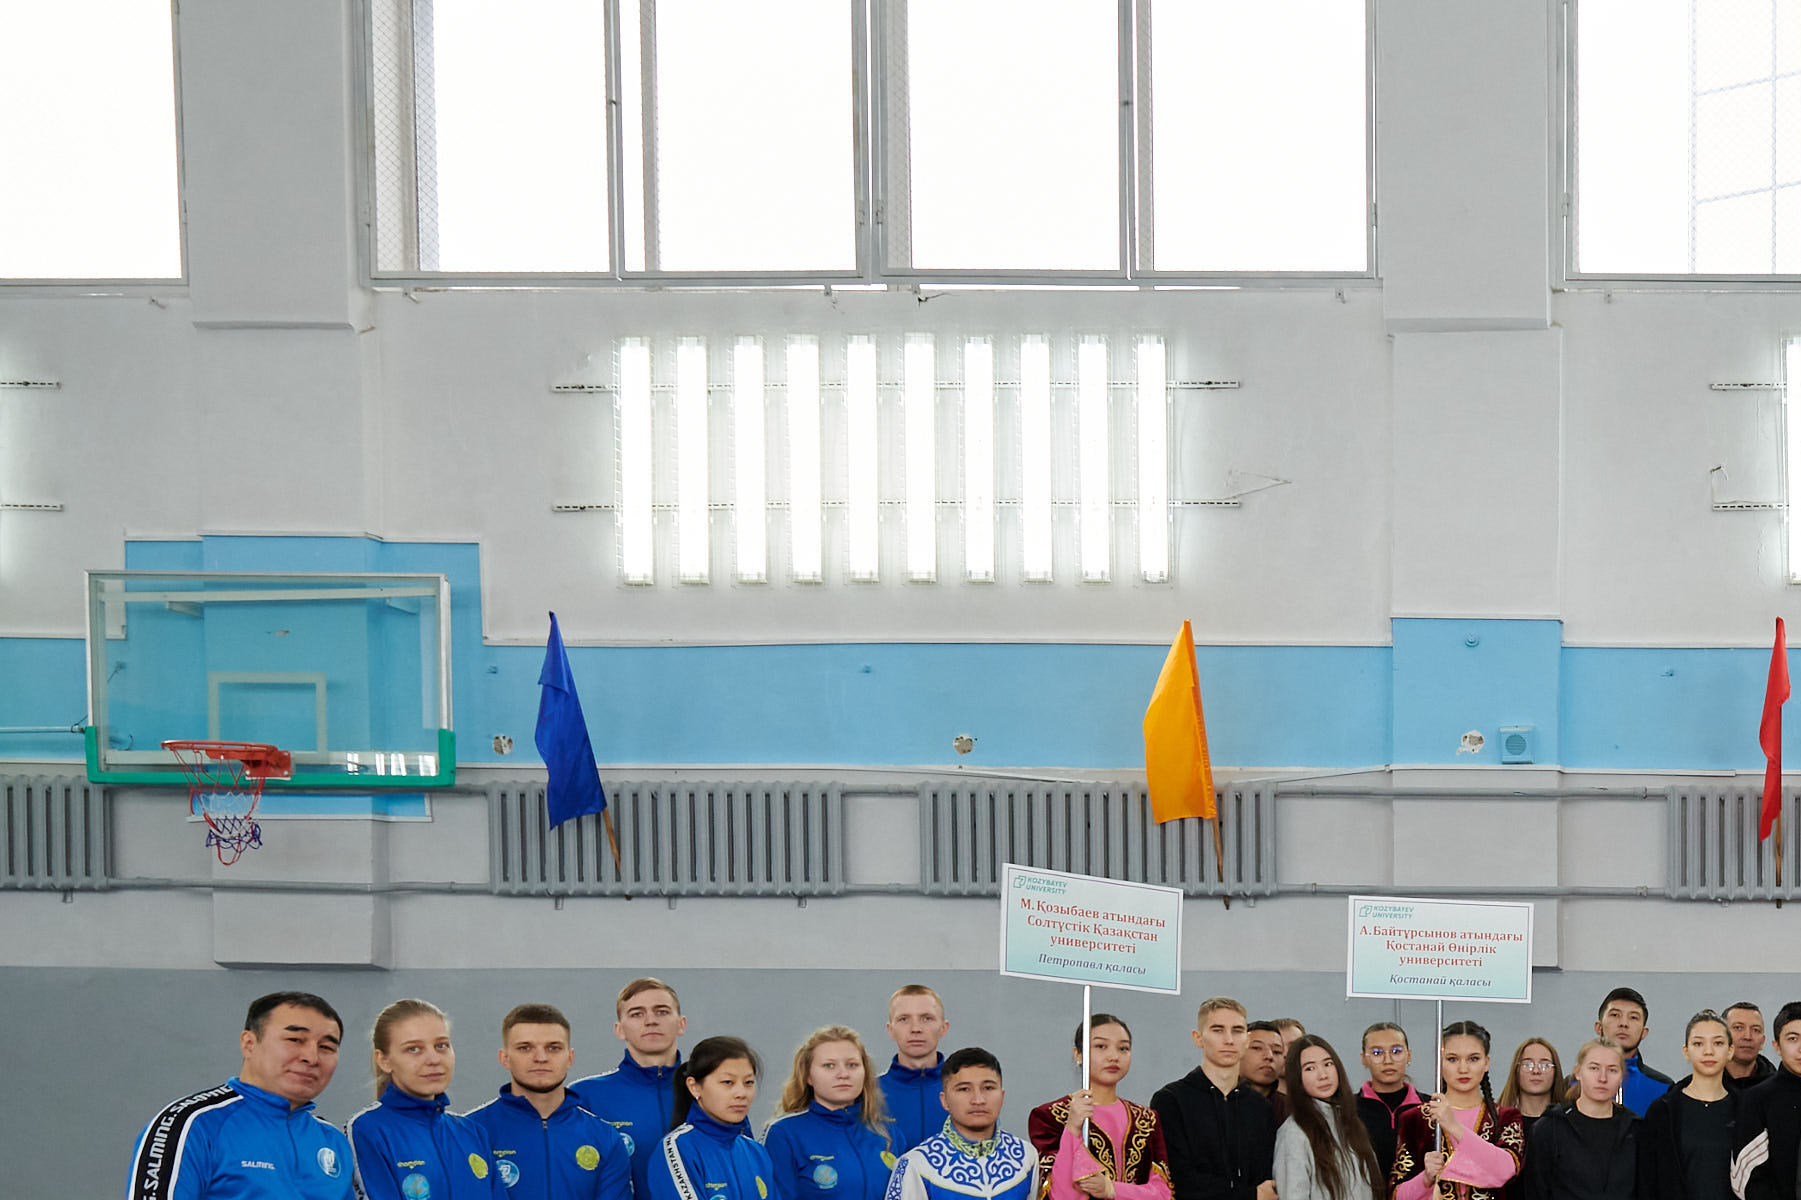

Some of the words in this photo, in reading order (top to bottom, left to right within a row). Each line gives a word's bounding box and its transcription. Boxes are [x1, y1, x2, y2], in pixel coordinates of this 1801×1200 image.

[1027, 877, 1068, 888] KOZYBAYEV
[1026, 884, 1066, 895] UNIVERSITY
[1372, 905, 1415, 913] KOZYBAYEV
[1103, 911, 1166, 928] атындағы
[1027, 915, 1090, 933] Солтүстік
[1093, 924, 1158, 942] Қазақстан
[1460, 931, 1523, 942] атындағы
[1050, 935, 1137, 954] университеті
[1386, 940, 1445, 952] Қостанай
[1038, 953, 1103, 971] Петропавл
[1106, 963, 1147, 975] қаласы
[1399, 955, 1483, 968] университеті
[1389, 974, 1447, 986] Қостанай
[1449, 978, 1492, 988] қаласы
[667, 1146, 693, 1200] KAZAKHSTAN
